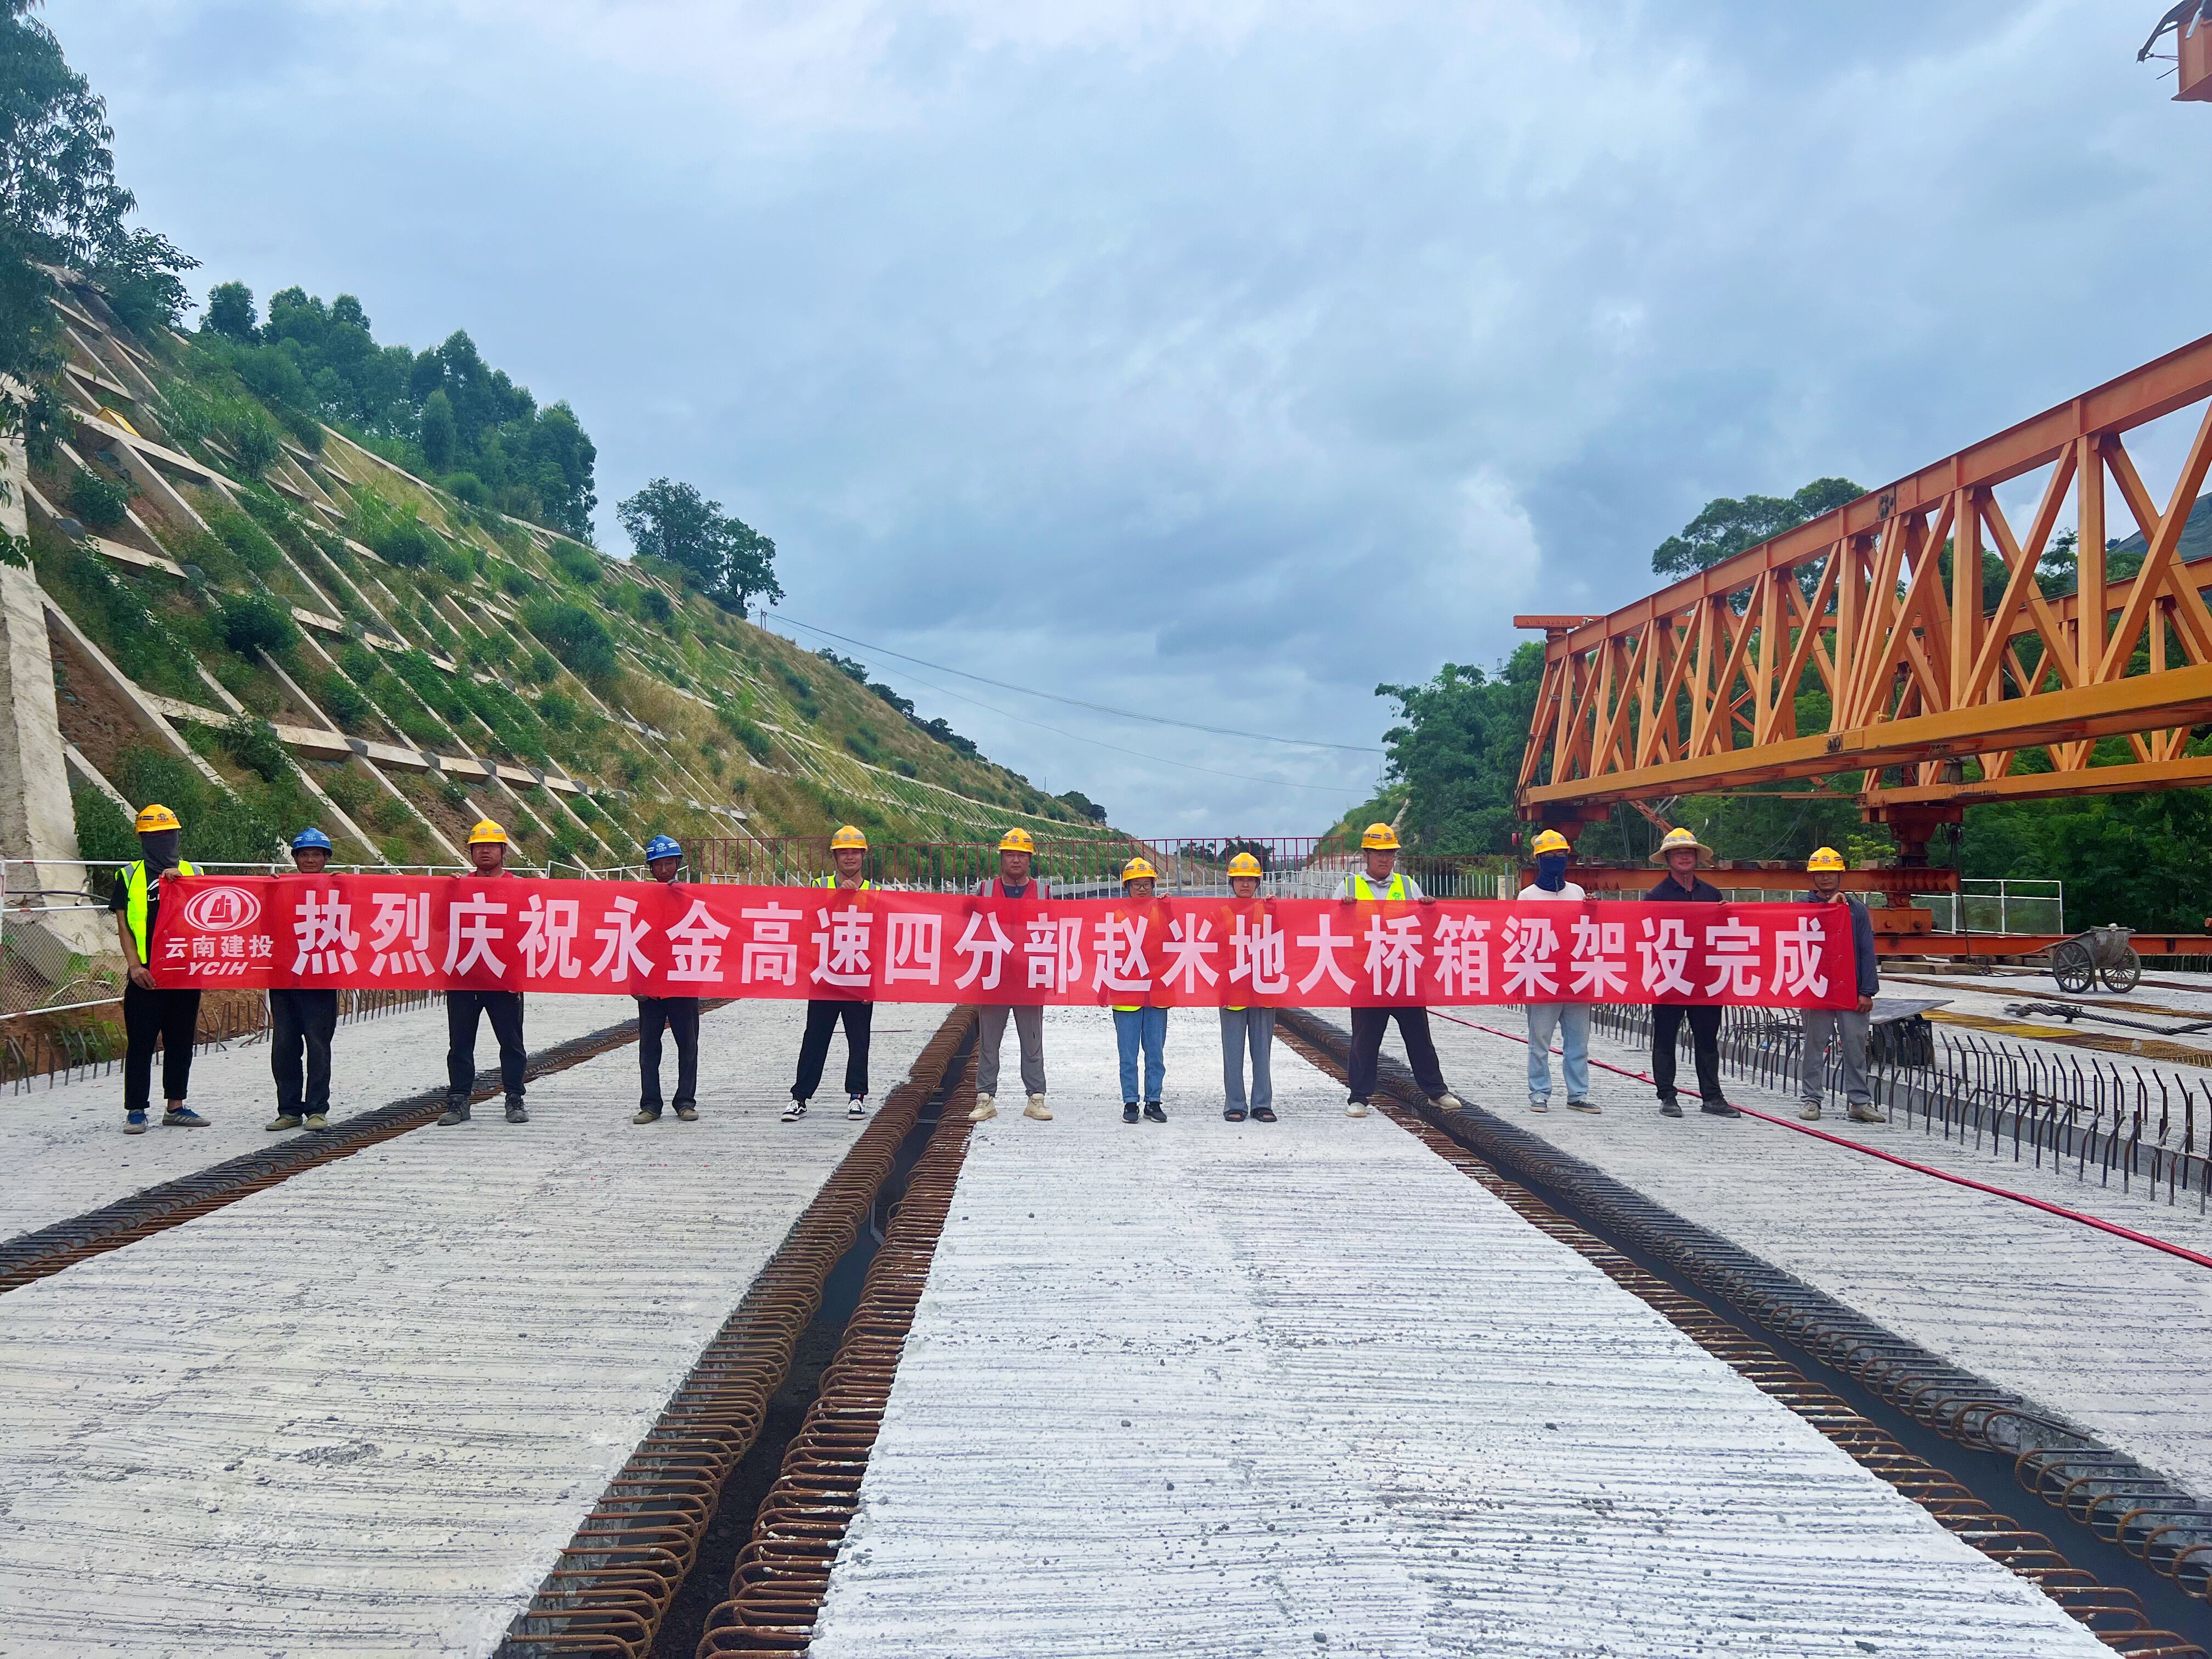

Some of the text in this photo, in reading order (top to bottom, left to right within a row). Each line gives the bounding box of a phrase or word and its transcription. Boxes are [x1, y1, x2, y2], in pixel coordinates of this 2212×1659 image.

[165, 934, 274, 958] 云南建投
[291, 889, 1828, 998] 热烈庆祝永金高速四分部赵米地大桥箱梁架设完成
[188, 961, 249, 975] YCIH
